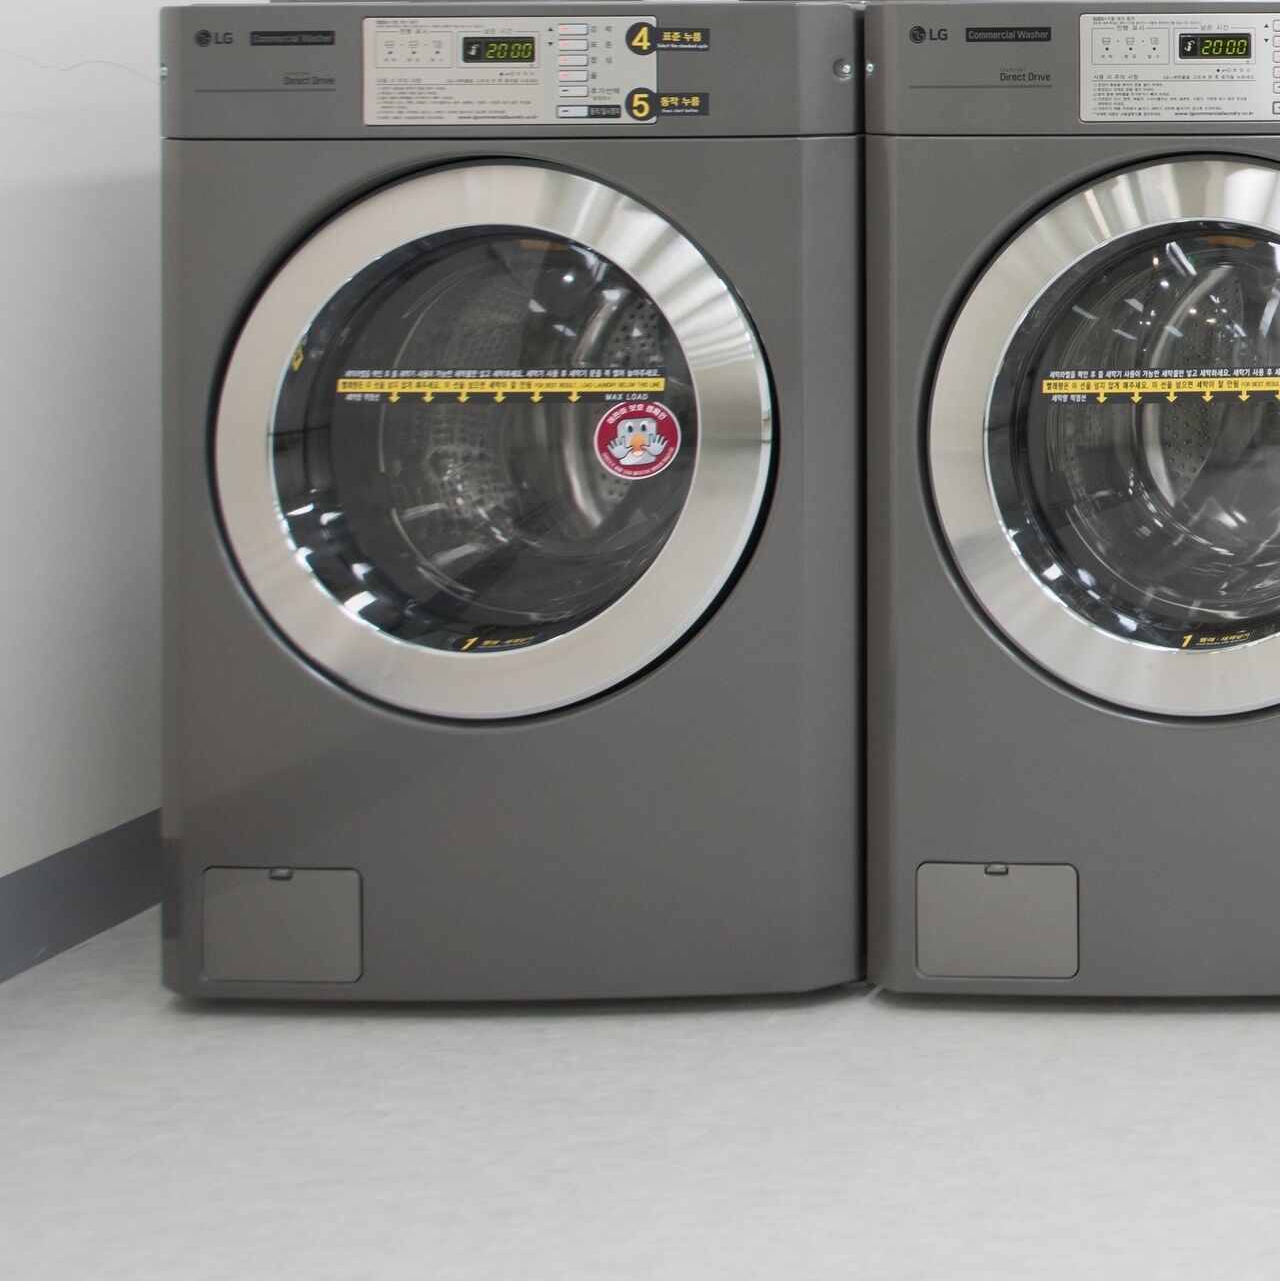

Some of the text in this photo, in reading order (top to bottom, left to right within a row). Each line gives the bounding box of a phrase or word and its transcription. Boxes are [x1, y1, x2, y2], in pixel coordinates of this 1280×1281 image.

[214, 33, 234, 45] LG
[631, 27, 650, 50] 4
[662, 31, 702, 42] 표준 누름
[929, 29, 948, 41] LG
[968, 30, 1048, 39] Commercial Washer
[1000, 73, 1050, 81] Direct Drive
[632, 93, 650, 117] 5
[660, 97, 700, 107] 동작 누름
[604, 393, 648, 401] MAX LOAD
[460, 637, 479, 651] 1
[1181, 634, 1193, 647] 1
